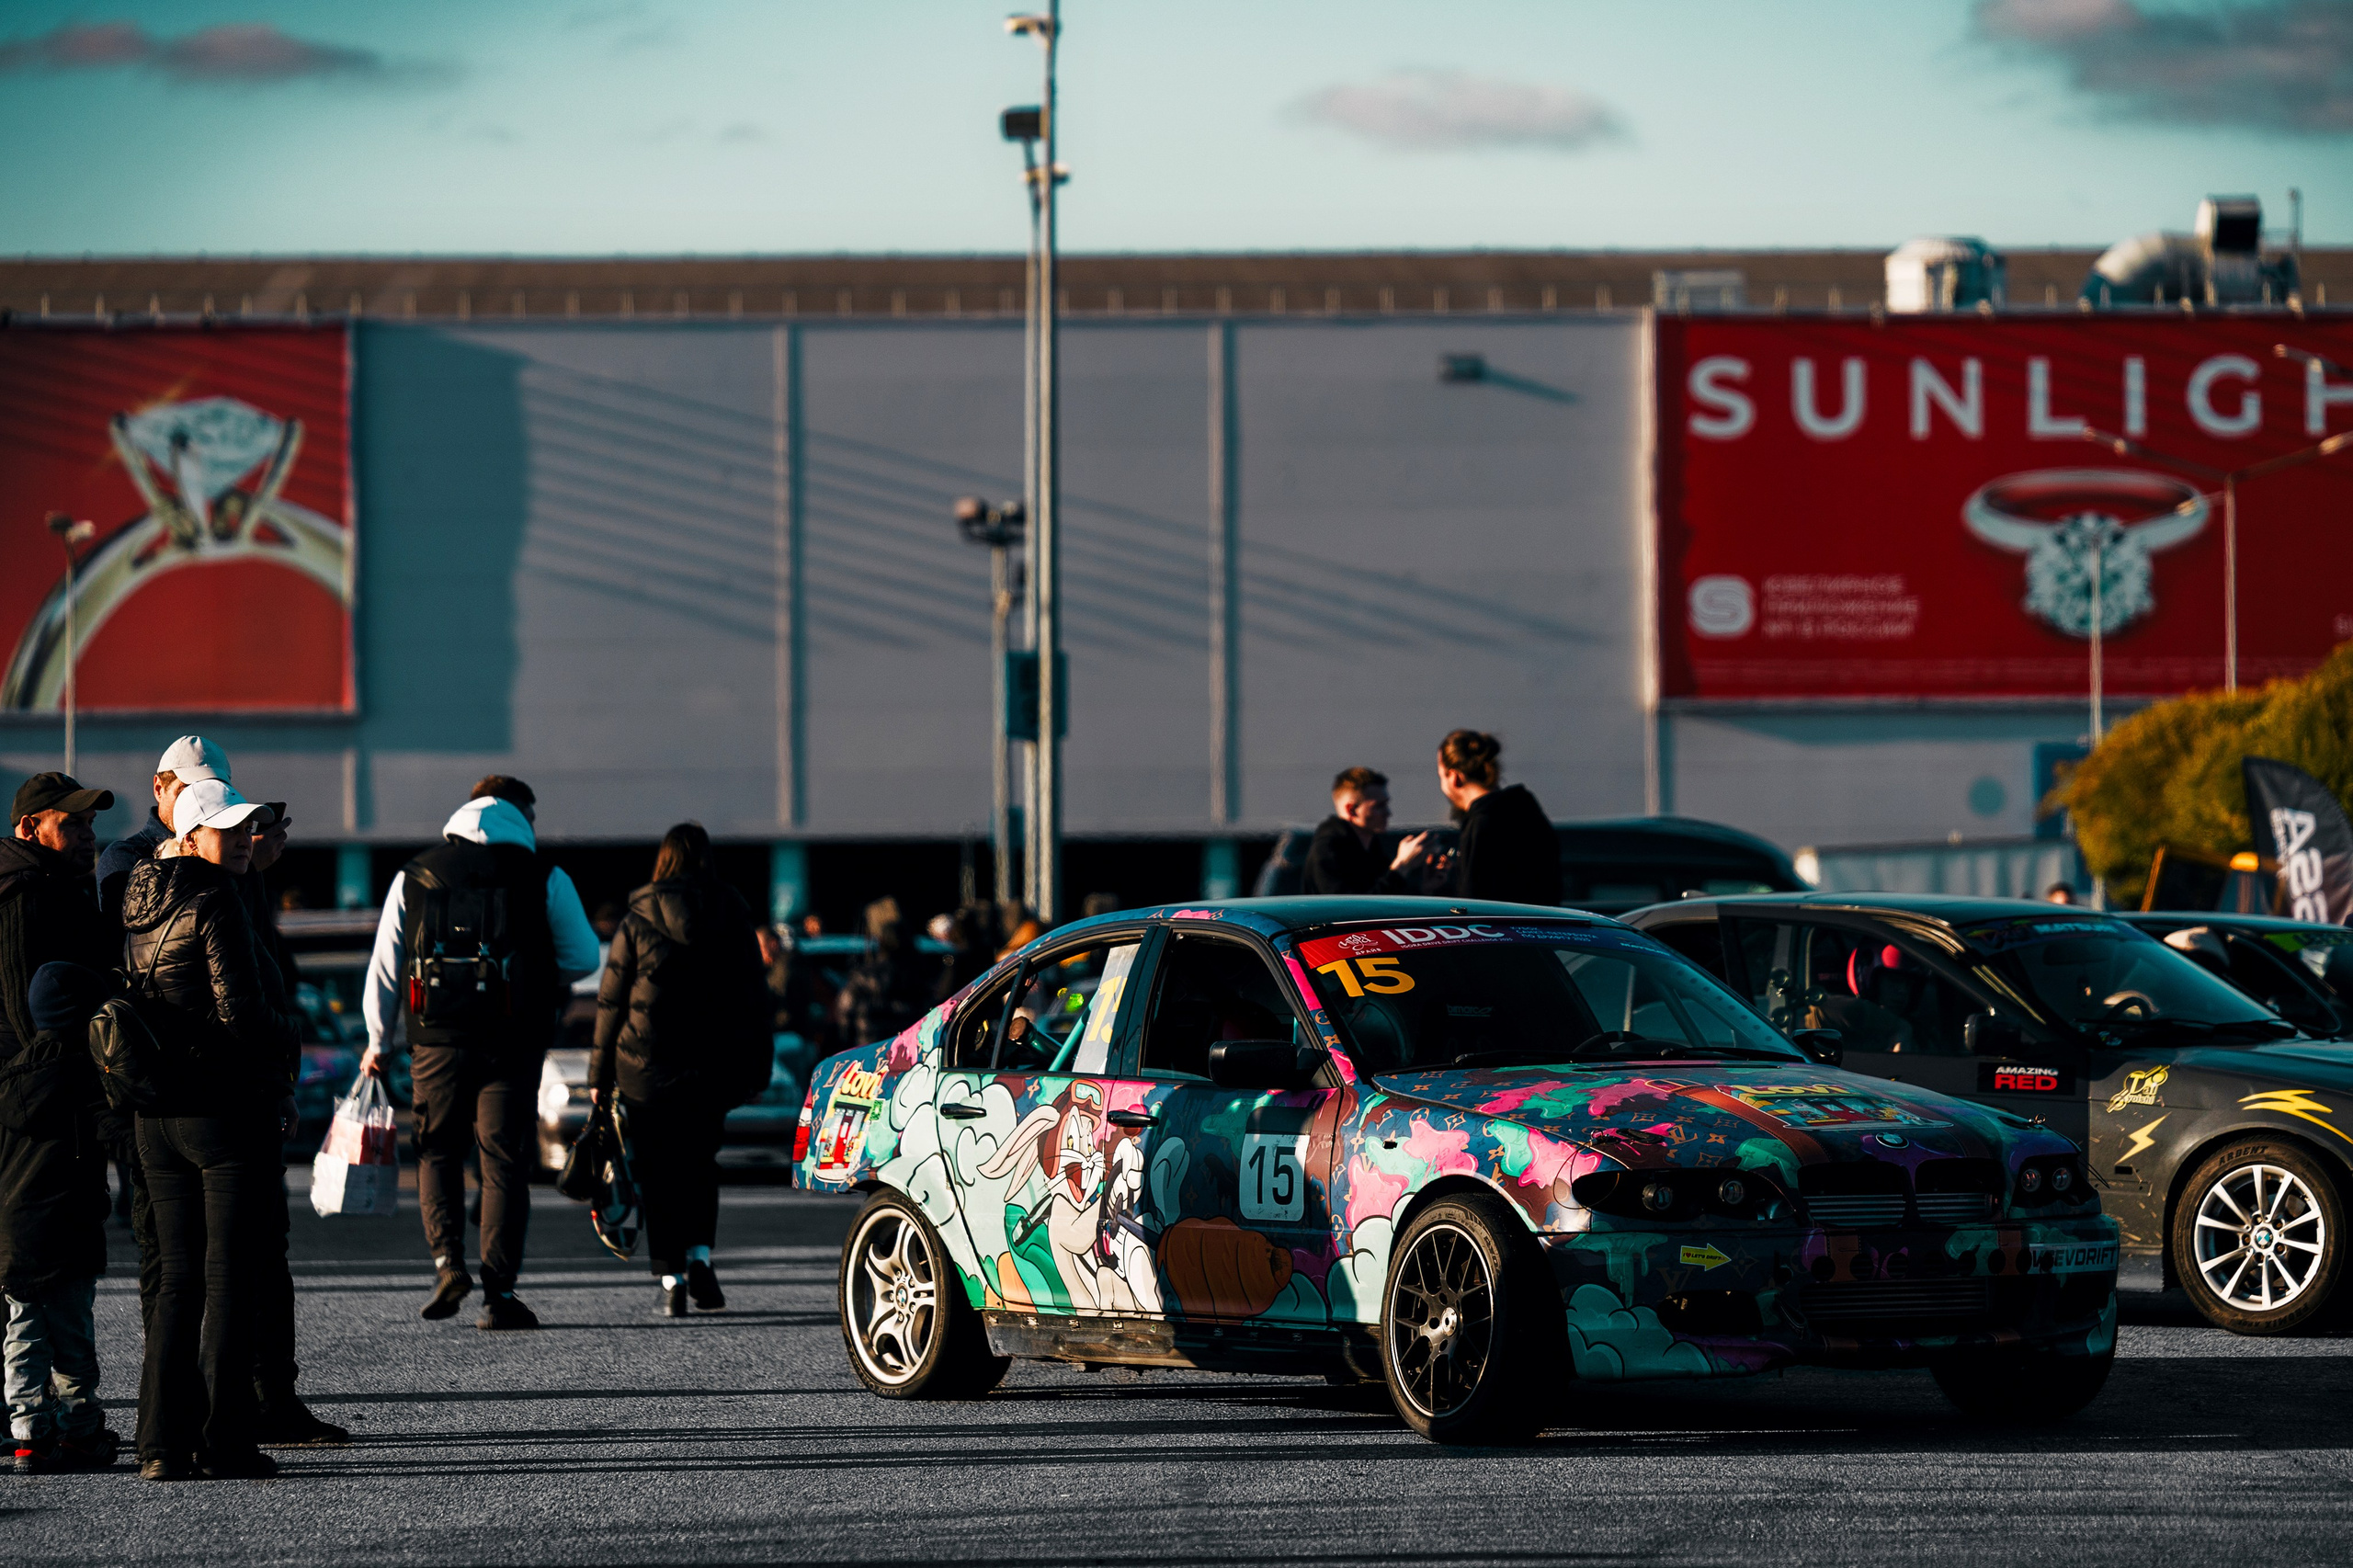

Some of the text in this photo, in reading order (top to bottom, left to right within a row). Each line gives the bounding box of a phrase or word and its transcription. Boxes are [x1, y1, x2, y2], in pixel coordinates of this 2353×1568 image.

[1381, 924, 1506, 945] IDDC
[1355, 948, 1381, 956] ДРАЙВ
[1316, 957, 1415, 997] 15
[1995, 1065, 2059, 1076] AMAZING
[1994, 1074, 2058, 1091] RED
[2219, 1145, 2269, 1166] ARDENT
[1248, 1145, 1296, 1205] 15
[2032, 1246, 2116, 1267] VEVDRIFT
